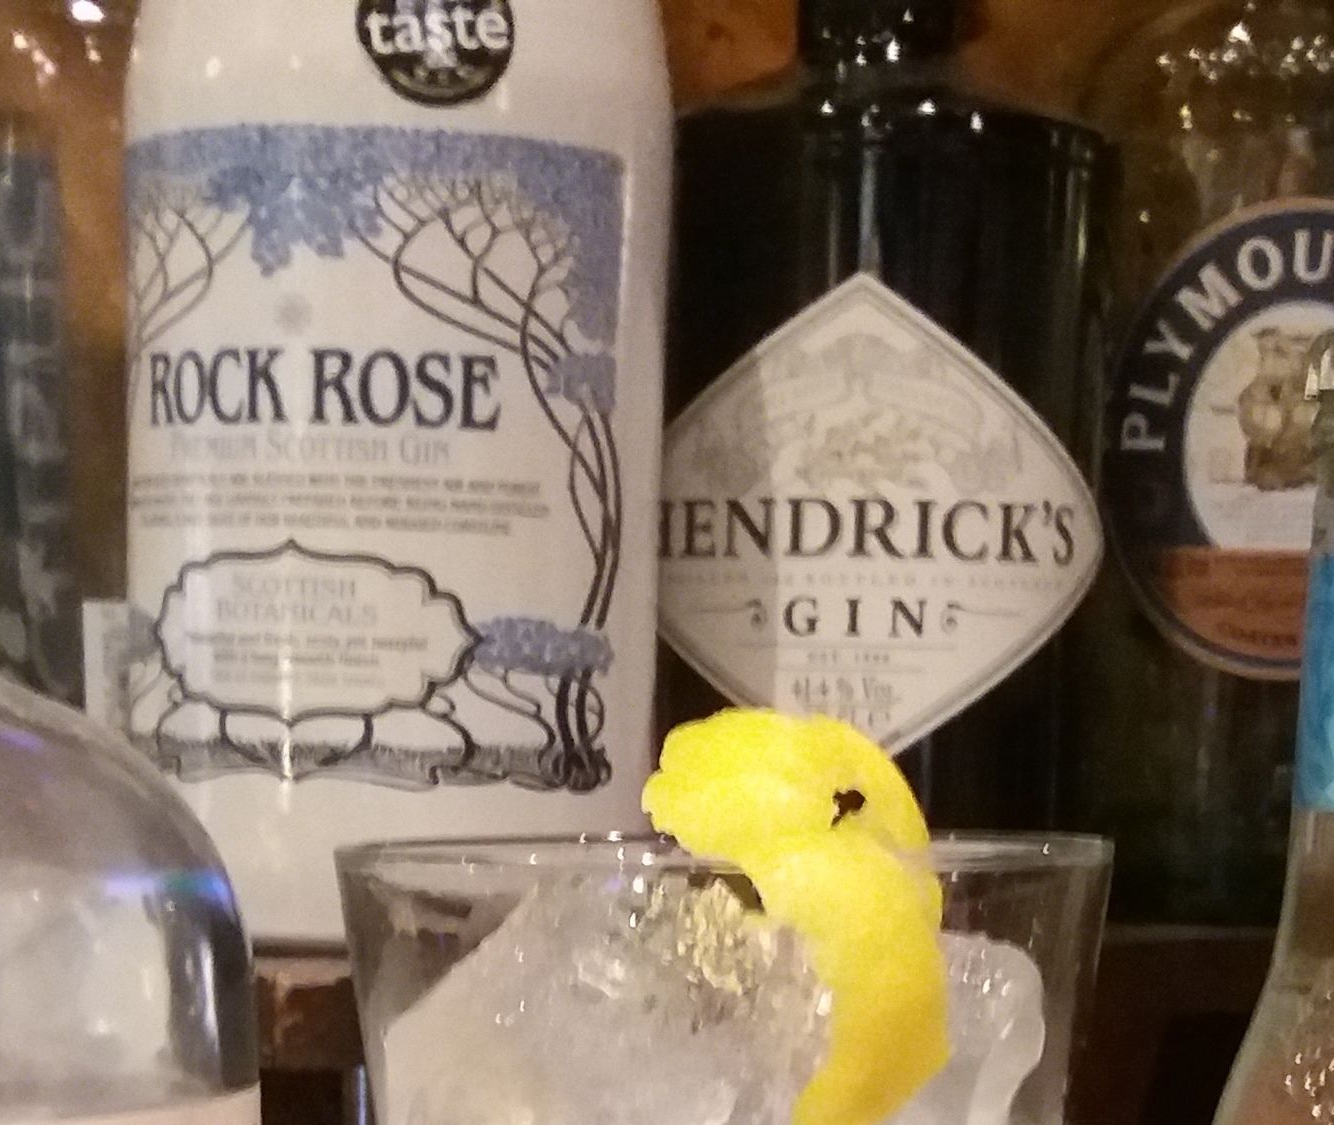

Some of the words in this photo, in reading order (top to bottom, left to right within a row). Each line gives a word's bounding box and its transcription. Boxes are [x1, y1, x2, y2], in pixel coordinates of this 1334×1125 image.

[366, 4, 509, 55] taste
[150, 343, 287, 428] ROCK
[310, 346, 500, 431] ROSE
[782, 594, 928, 638] GIN
